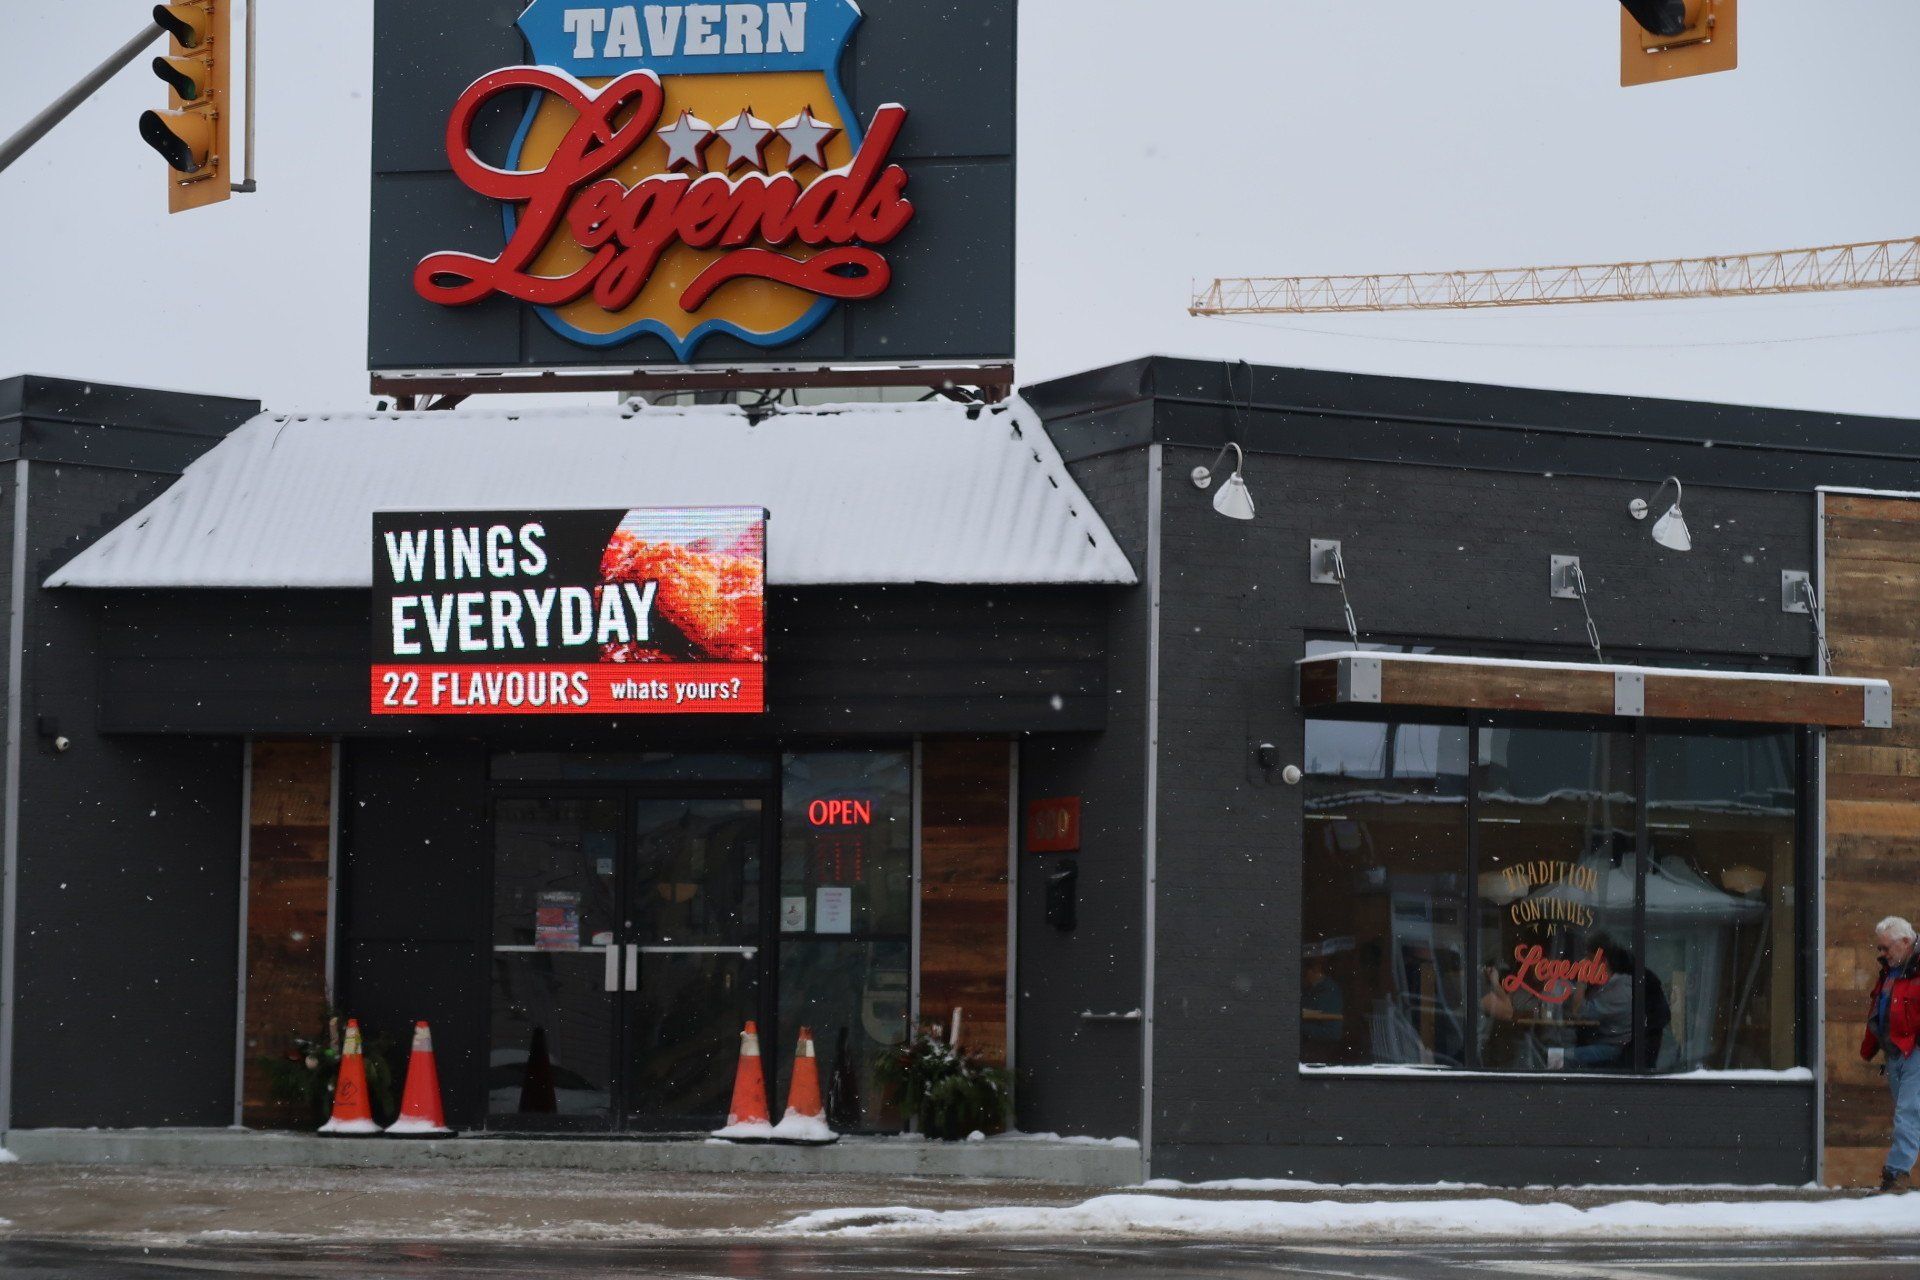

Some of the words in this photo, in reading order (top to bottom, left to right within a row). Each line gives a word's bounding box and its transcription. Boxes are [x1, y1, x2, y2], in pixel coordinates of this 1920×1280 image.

[564, 3, 805, 58] TAVERN
[413, 65, 915, 311] Legends
[384, 523, 548, 583] WINGS
[391, 581, 657, 654] EVERYDAY
[382, 674, 419, 706] 22
[431, 671, 589, 707] FLAVOURS
[610, 678, 669, 700] whats
[675, 677, 741, 704] yours?
[808, 799, 872, 826] OPEN
[1502, 860, 1598, 892] TRADITION
[1511, 897, 1594, 928] CONTINUES
[1502, 944, 1610, 1003] Legends
